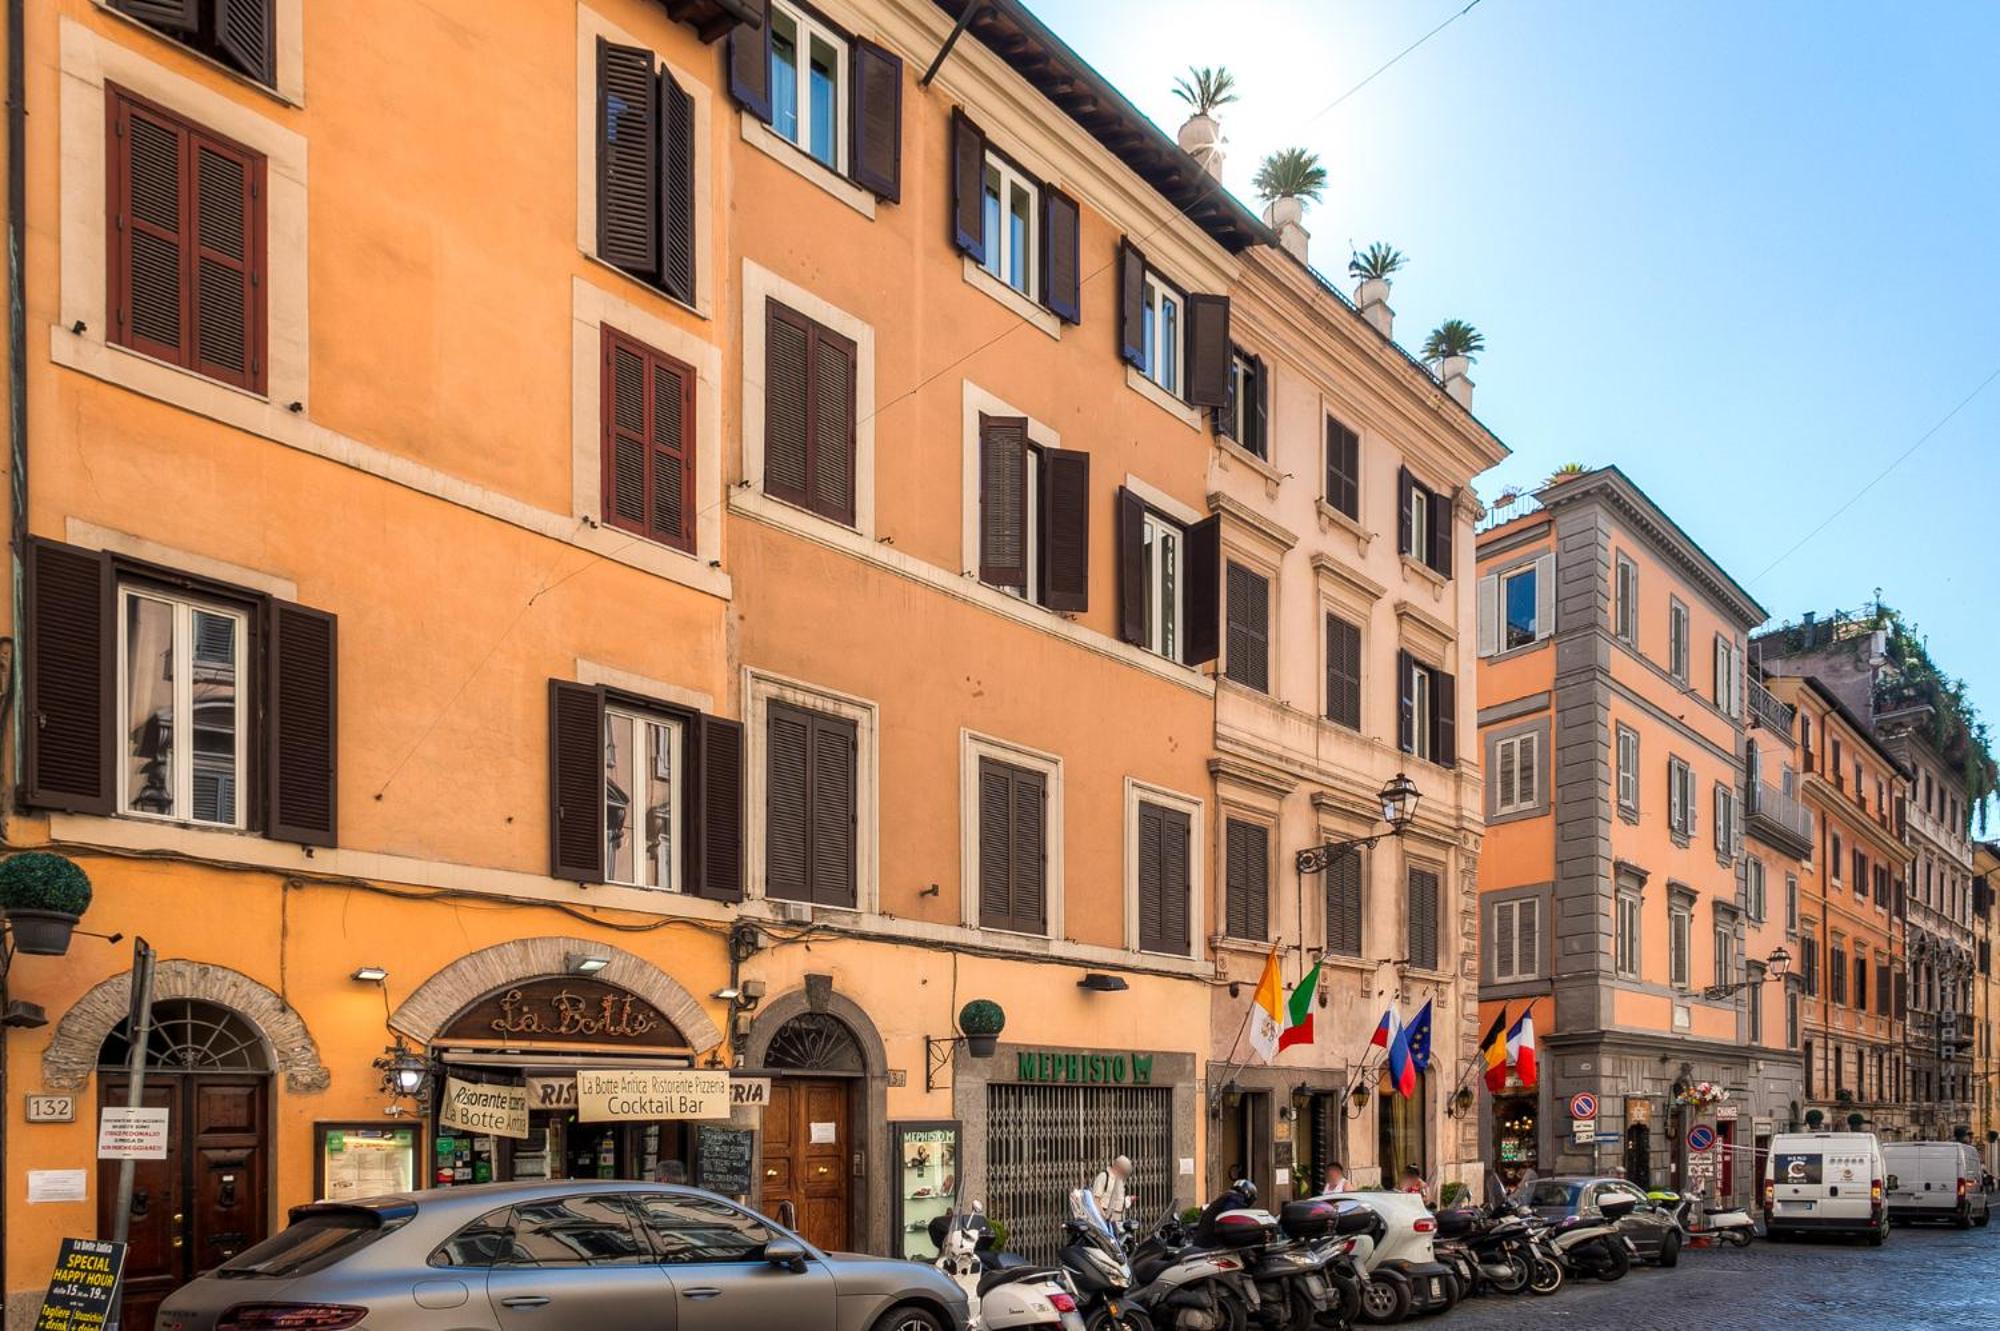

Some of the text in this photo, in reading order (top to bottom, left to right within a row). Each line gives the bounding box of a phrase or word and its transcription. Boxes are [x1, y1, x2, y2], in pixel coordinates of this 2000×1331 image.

[491, 989, 541, 1033] La
[1018, 1052, 1126, 1083] MEPHISTO
[540, 1083, 577, 1106] RIS
[582, 1076, 593, 1095] La
[595, 1076, 619, 1095] Botte
[620, 1076, 647, 1094] Antica
[652, 1076, 693, 1094] Ristorante
[32, 1099, 69, 1116] 132
[607, 1096, 704, 1115] Cocktail Bar
[460, 1107, 505, 1130] Botte
[904, 1131, 944, 1142] MEPHISTO
[66, 1254, 110, 1272] SPECIAL
[53, 1269, 114, 1287] HAPPY HOUR
